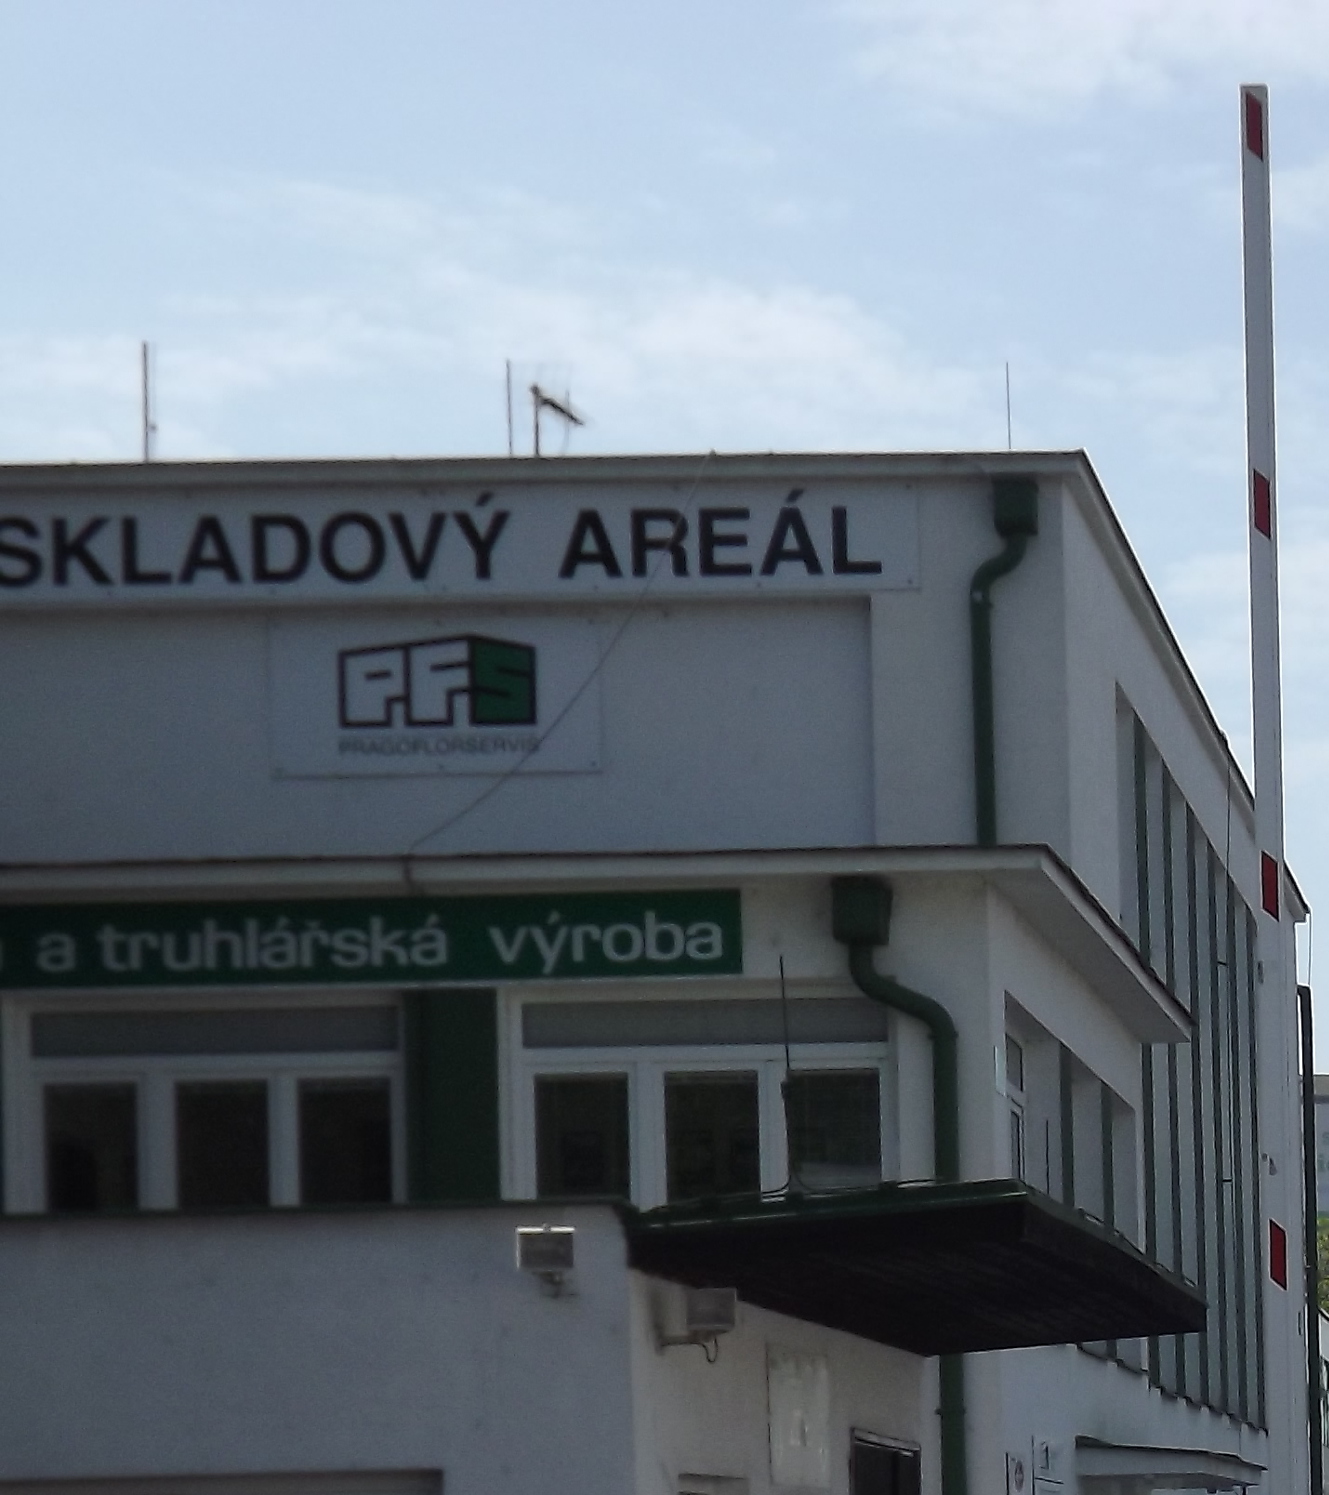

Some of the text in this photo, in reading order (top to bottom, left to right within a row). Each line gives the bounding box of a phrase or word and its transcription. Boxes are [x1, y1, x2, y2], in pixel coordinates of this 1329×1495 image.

[0, 488, 884, 587] SKLADOVÝ AREÁL
[36, 910, 724, 975] a truhlářská výroba
